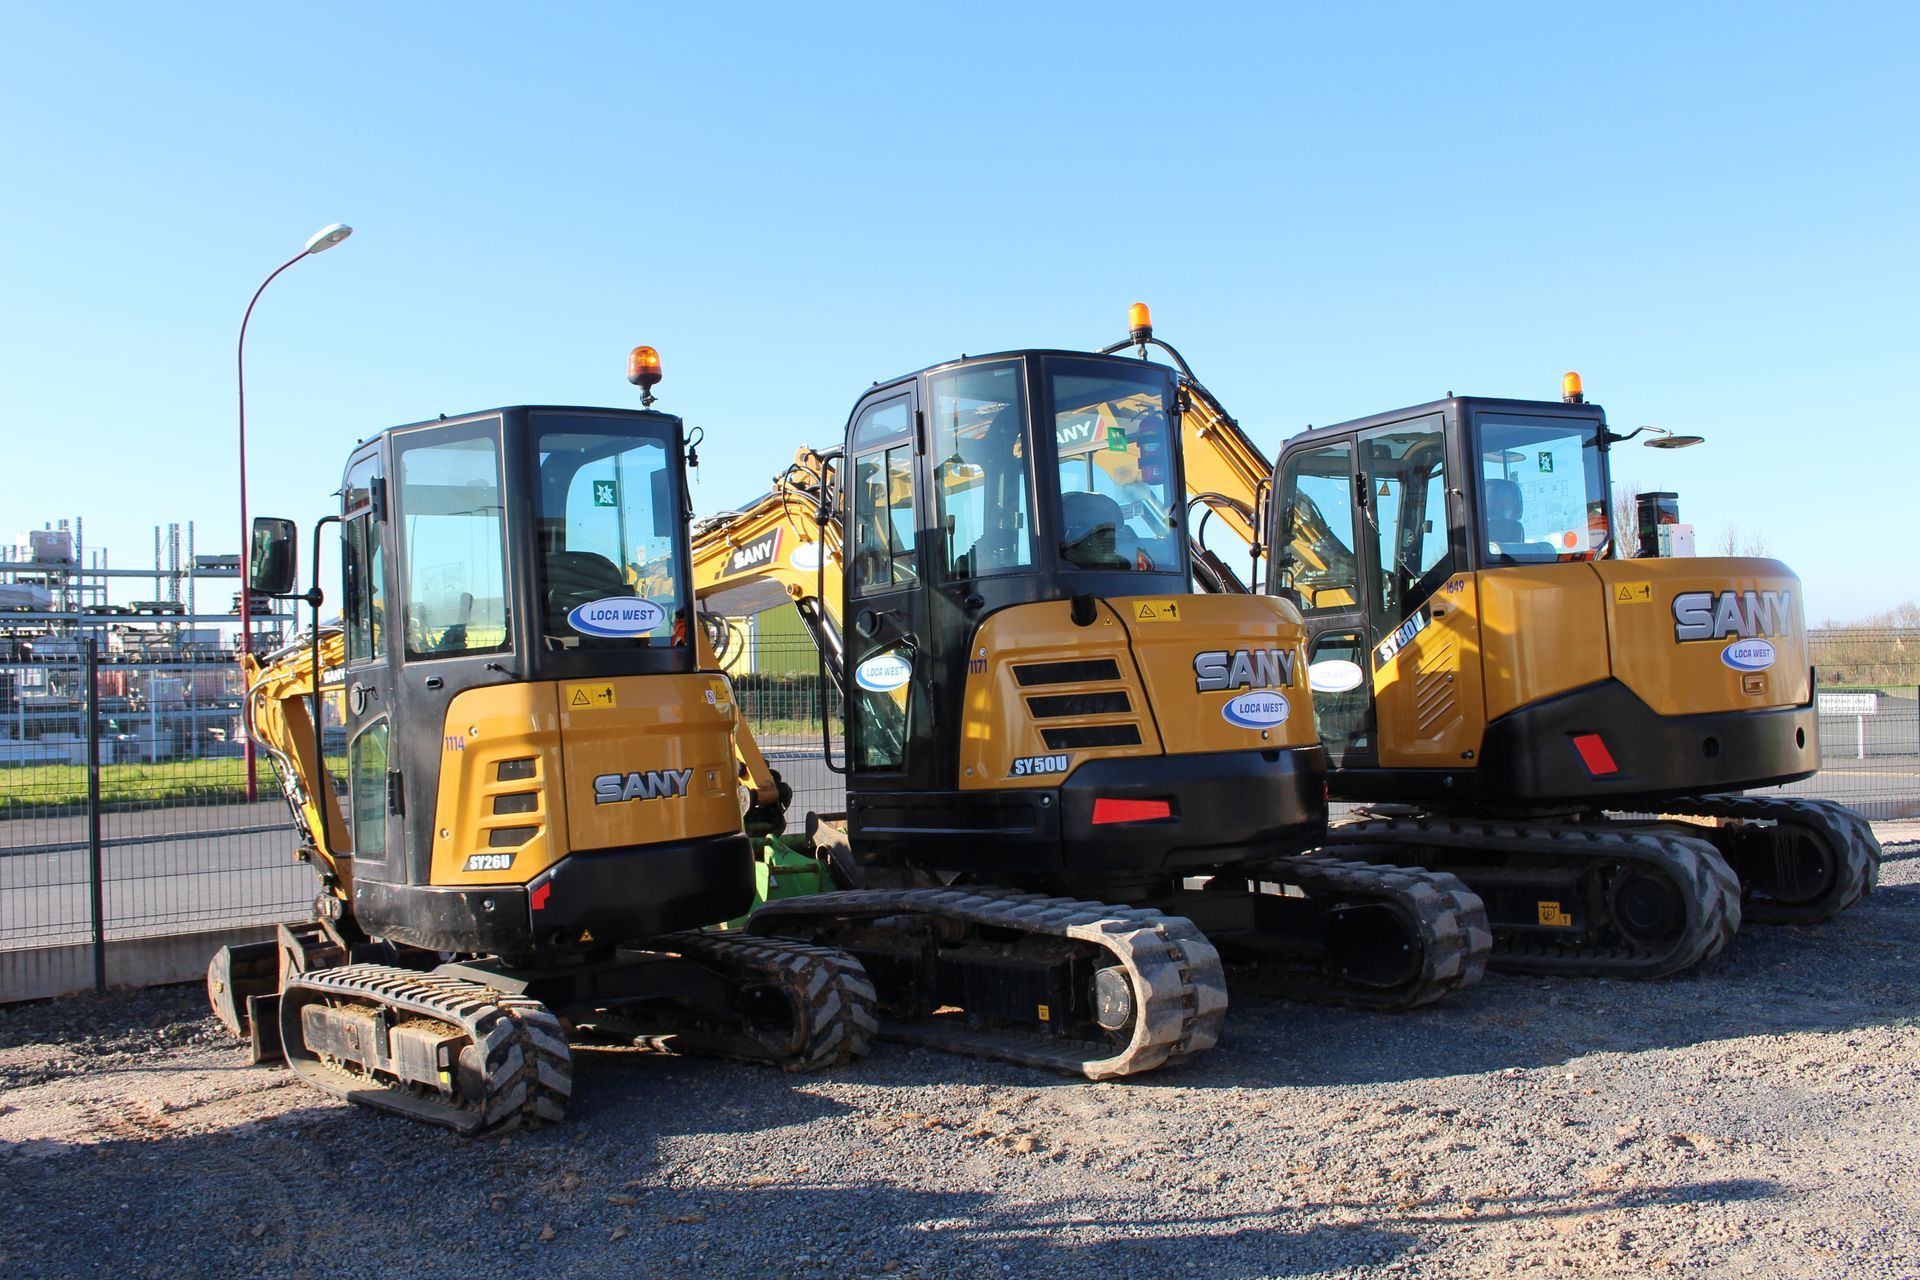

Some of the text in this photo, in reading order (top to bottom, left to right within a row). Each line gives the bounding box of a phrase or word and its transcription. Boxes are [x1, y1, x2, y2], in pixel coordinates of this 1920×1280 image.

[1056, 420, 1091, 444] ANY
[733, 539, 772, 570] SANY
[1445, 580, 1465, 594] 1649
[590, 609, 655, 621] LOCA WEST
[1672, 590, 1791, 643] SANY
[1379, 610, 1425, 662] SY80U
[1734, 648, 1771, 659] LOCA WEST
[866, 666, 905, 677] LOCA WEST
[970, 658, 988, 674] 1171
[1193, 649, 1295, 693] SANY
[1239, 702, 1284, 714] LOCA WEST
[445, 735, 465, 752] 1114
[1014, 755, 1068, 775] SY50U
[592, 767, 694, 805] SANY
[469, 853, 511, 870] SY26U
